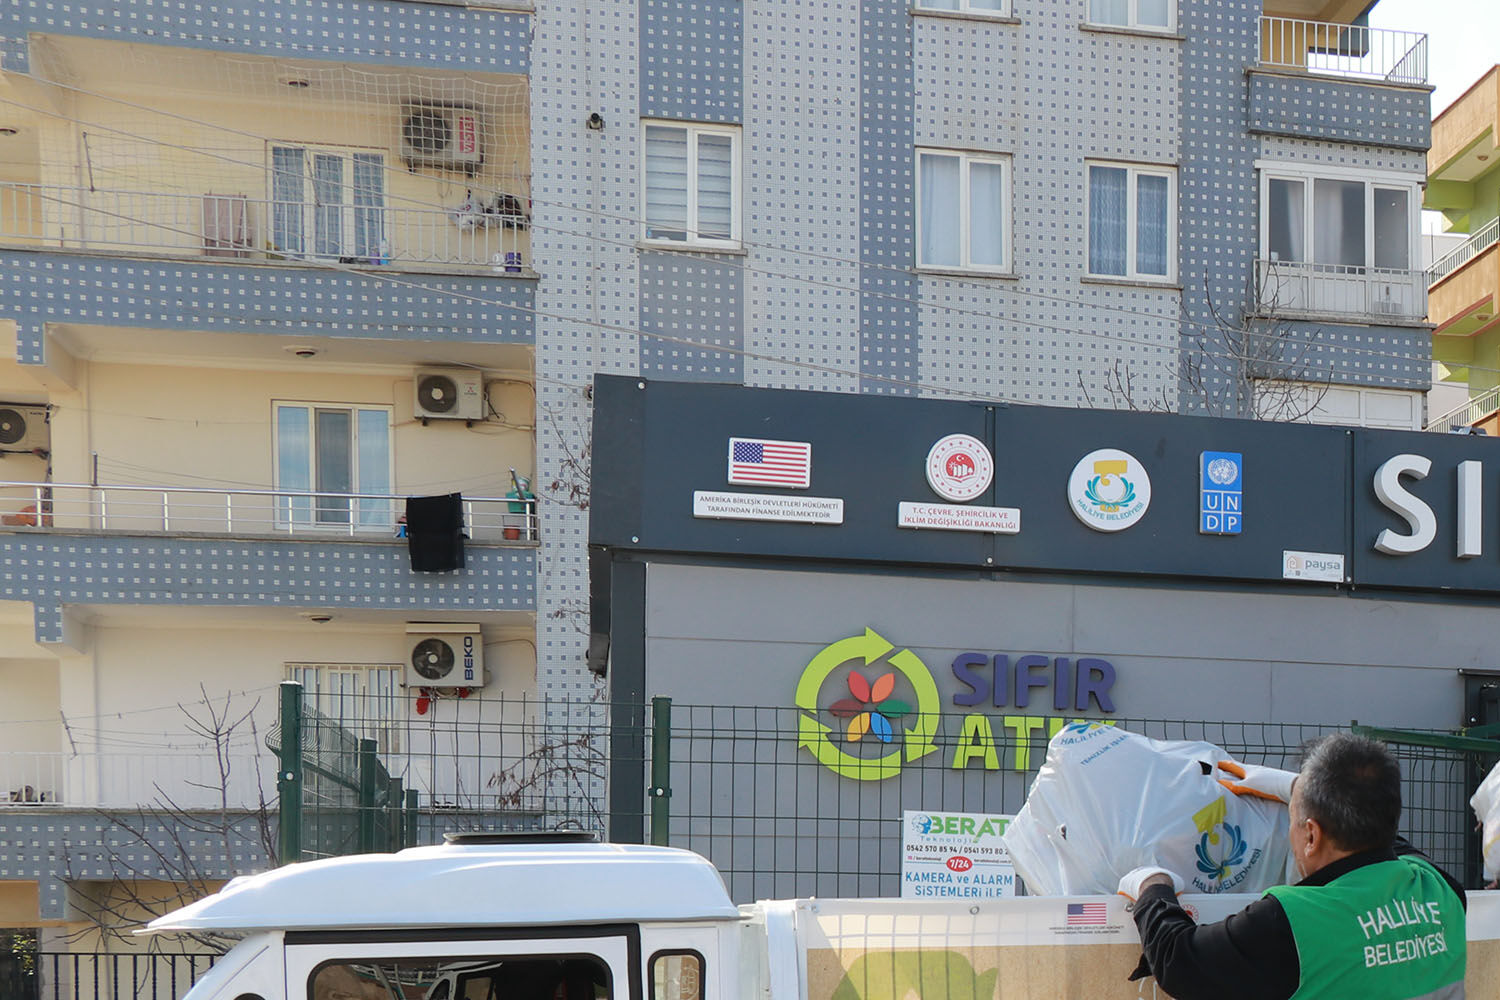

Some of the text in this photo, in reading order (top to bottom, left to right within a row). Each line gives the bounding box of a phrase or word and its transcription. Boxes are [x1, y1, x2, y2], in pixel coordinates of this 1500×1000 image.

[699, 494, 839, 510] AMERİKA BİRLEŞİK DEVLETLERİ HÜKÜMETİ
[707, 505, 831, 519] TARAFINDAN FİNANSE EDİLMEKTEDİR
[912, 507, 927, 515] T.C.
[1304, 559, 1341, 572] paysa
[463, 636, 474, 681] BEKO
[951, 652, 1117, 713] SIFIR
[929, 815, 1010, 842] BERAT
[906, 844, 923, 852] 0542
[924, 845, 938, 853] 570
[939, 845, 948, 853] 85
[949, 858, 970, 870] 7/24
[905, 871, 1013, 886] KAMERA ve ALARM
[1357, 896, 1442, 940] HALİLİYE
[1363, 927, 1448, 968] BELEDİYESİ
